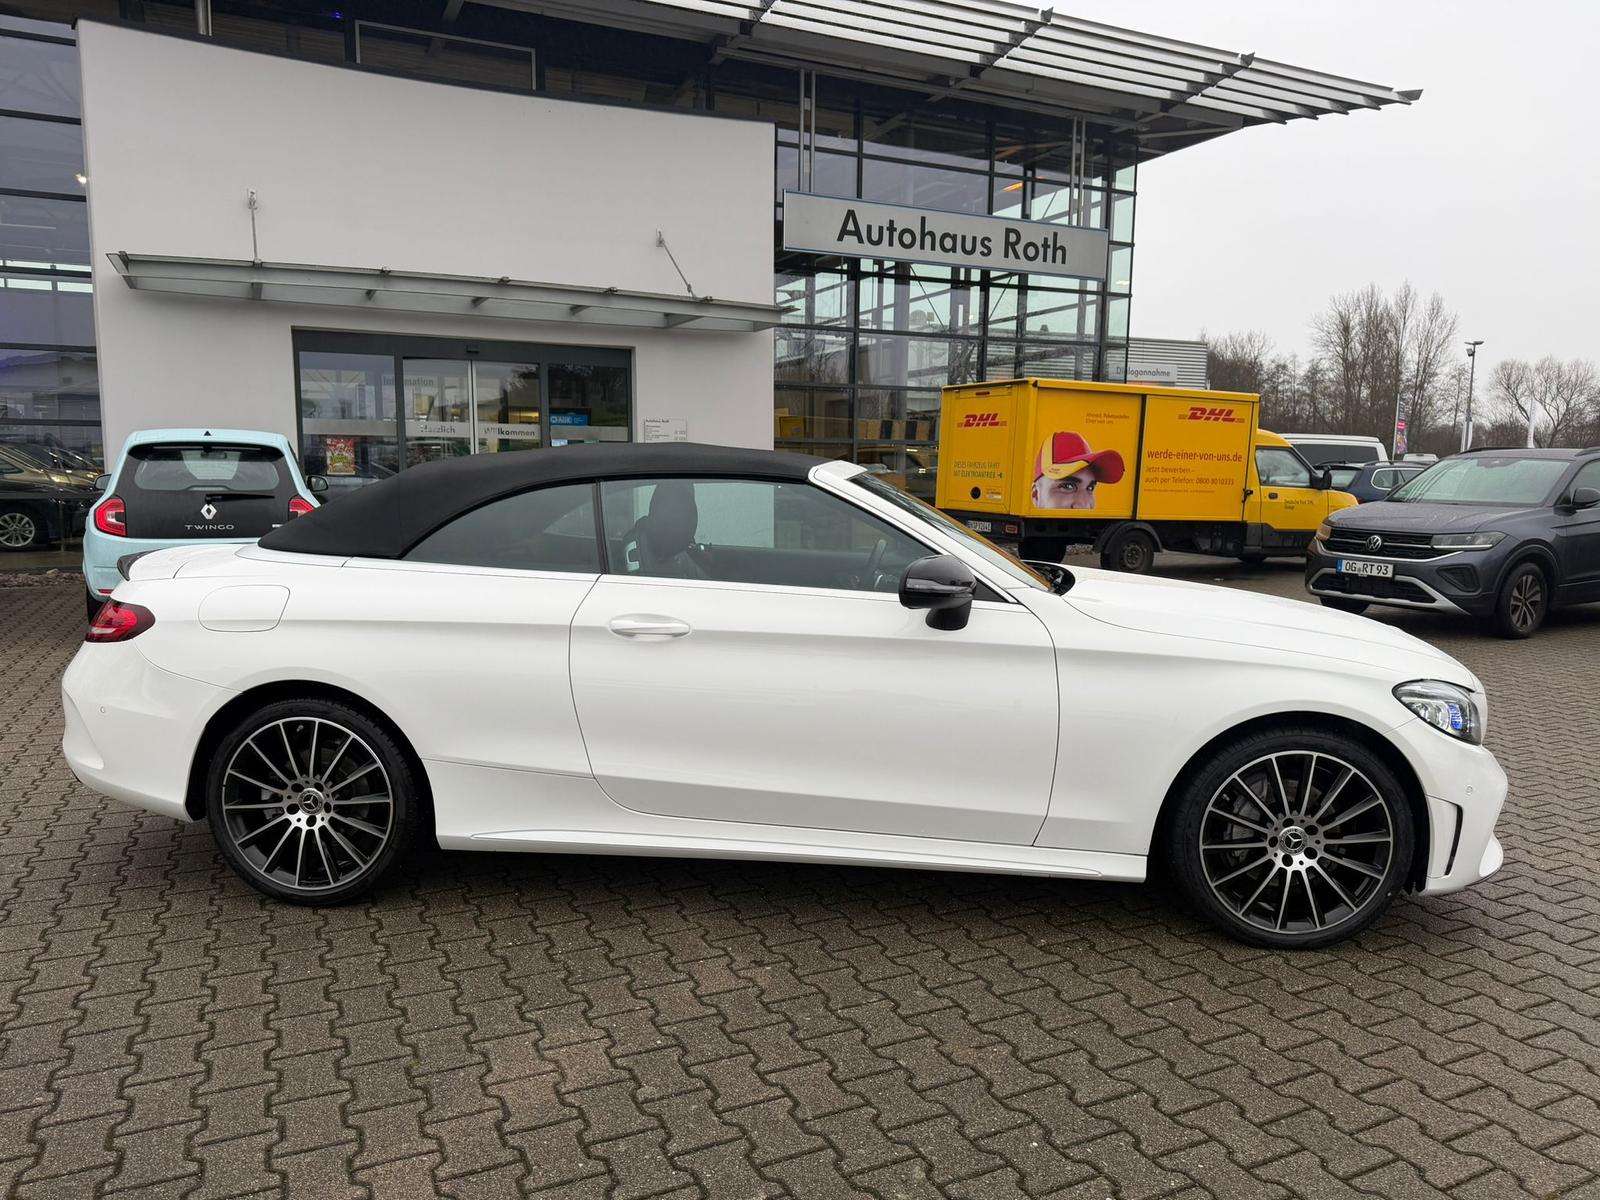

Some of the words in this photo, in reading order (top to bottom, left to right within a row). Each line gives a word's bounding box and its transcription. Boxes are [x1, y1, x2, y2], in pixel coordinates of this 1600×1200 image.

[836, 208, 993, 258] Autohaus
[1003, 226, 1068, 265] Roth
[1116, 366, 1171, 378] Dilogannahme
[964, 413, 1000, 427] DHL
[1187, 406, 1235, 423] DHL
[1146, 448, 1243, 462] werde-einer-von-uns.de
[1345, 561, 1357, 572] OG
[1362, 563, 1375, 574] RT
[1376, 565, 1389, 576] 93
